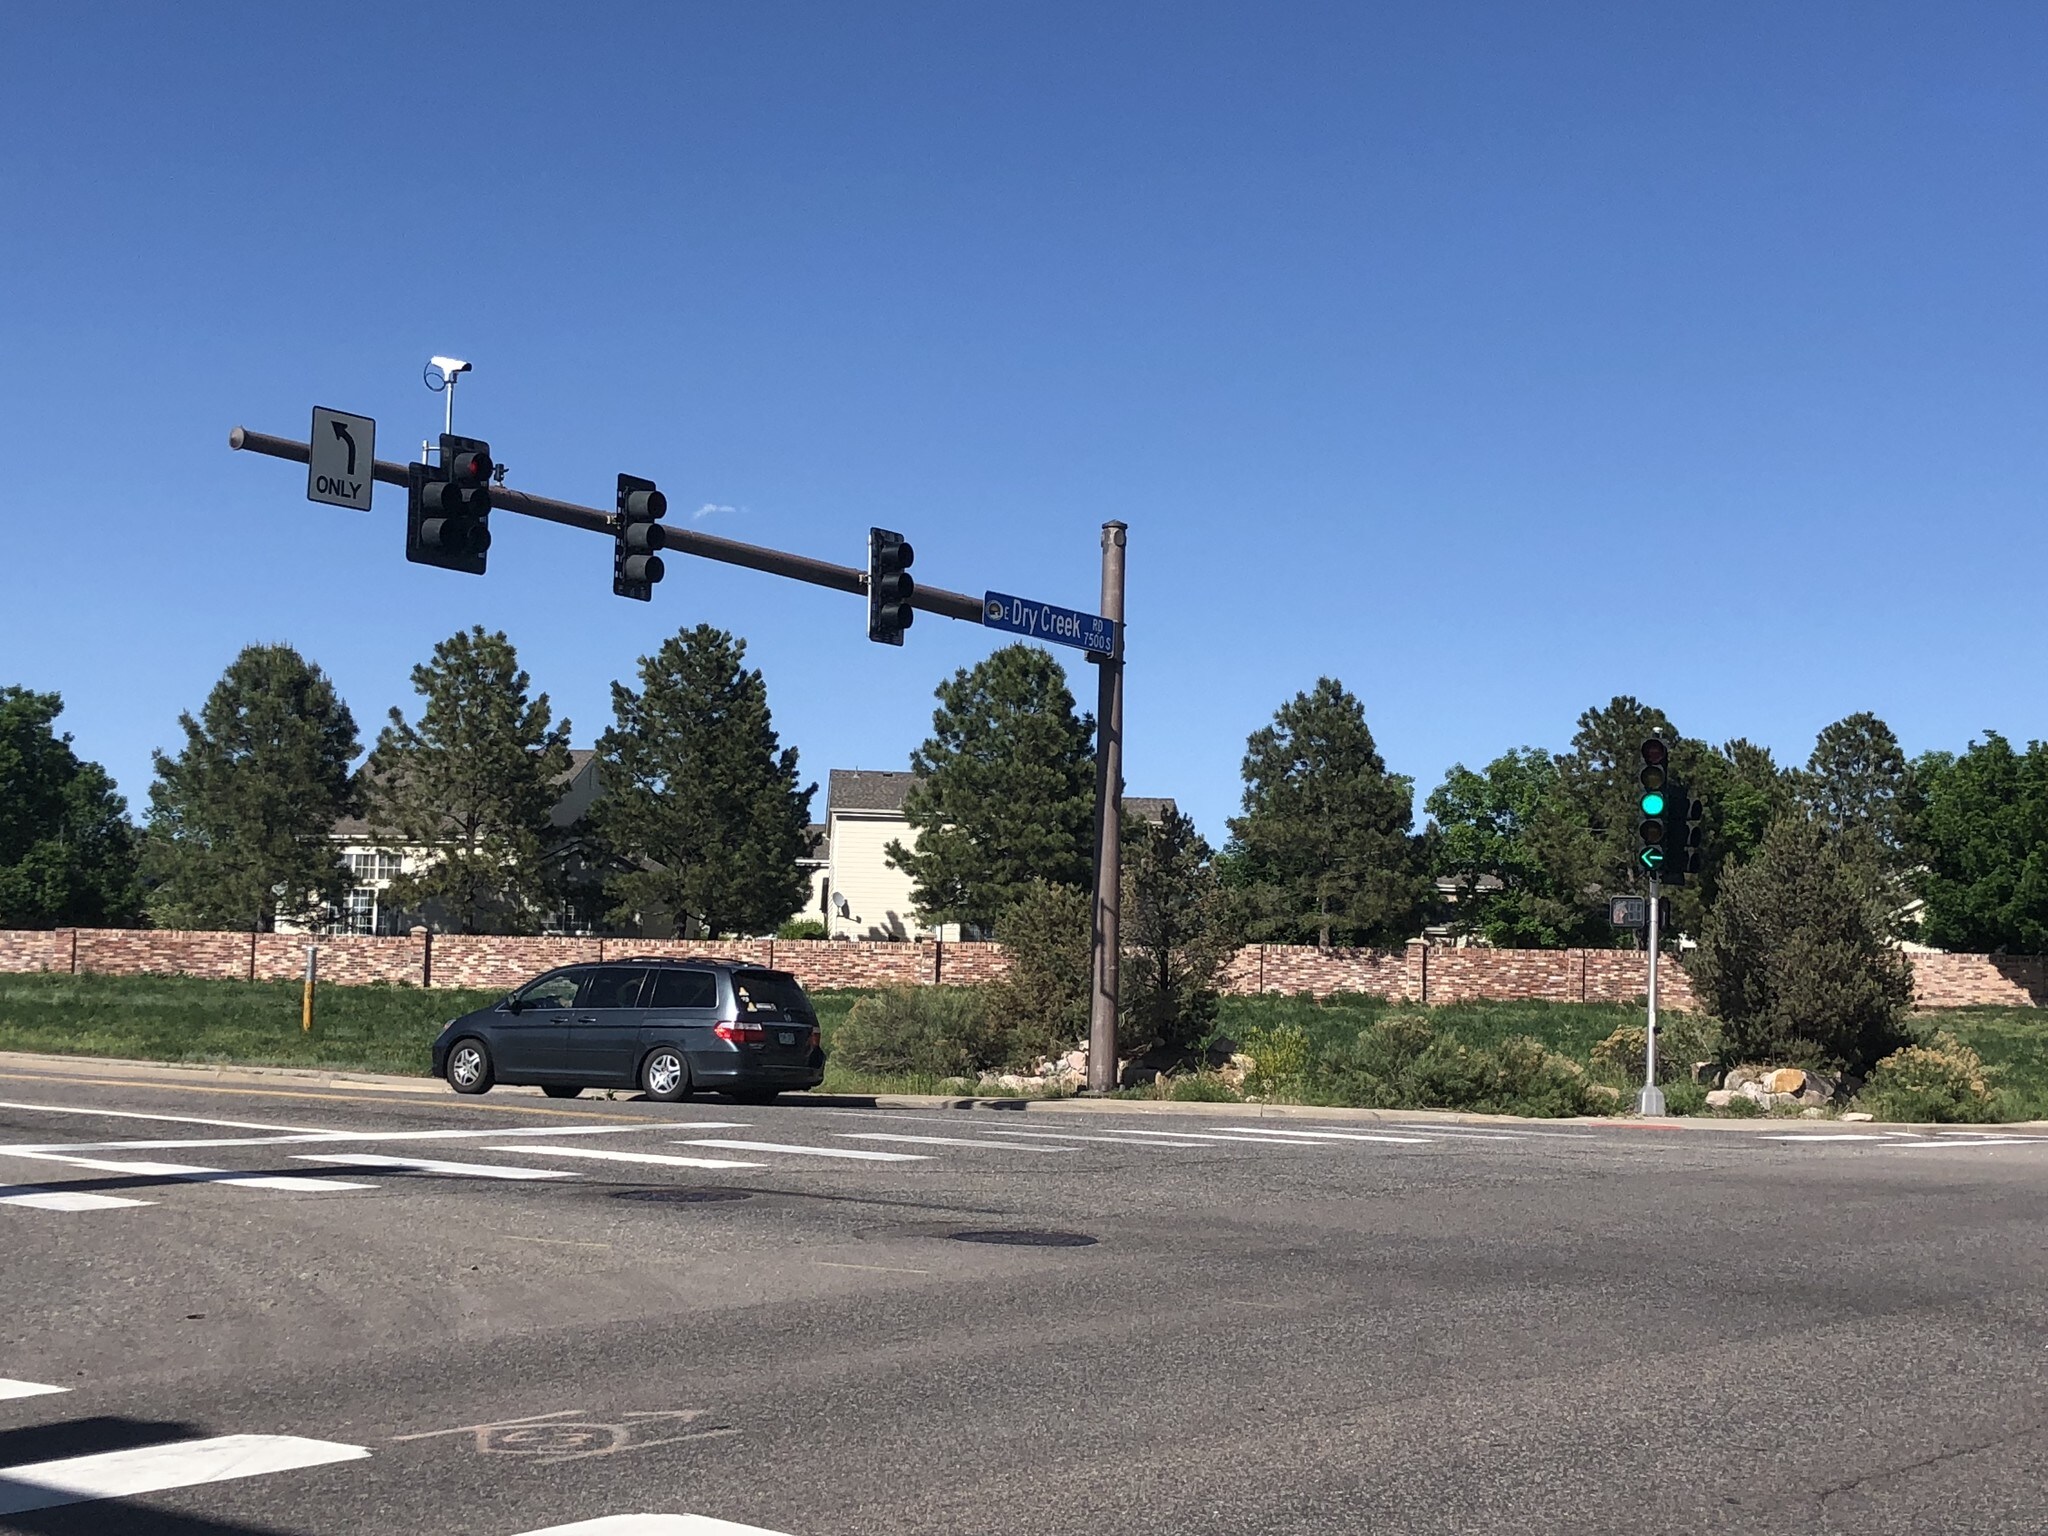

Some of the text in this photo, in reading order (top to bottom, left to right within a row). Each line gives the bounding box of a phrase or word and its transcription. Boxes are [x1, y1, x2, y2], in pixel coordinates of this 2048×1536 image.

[317, 475, 362, 499] ONLY
[1004, 598, 1081, 639] E Dry Creek
[1092, 618, 1103, 633] RD
[1083, 632, 1111, 650] 7500 S
